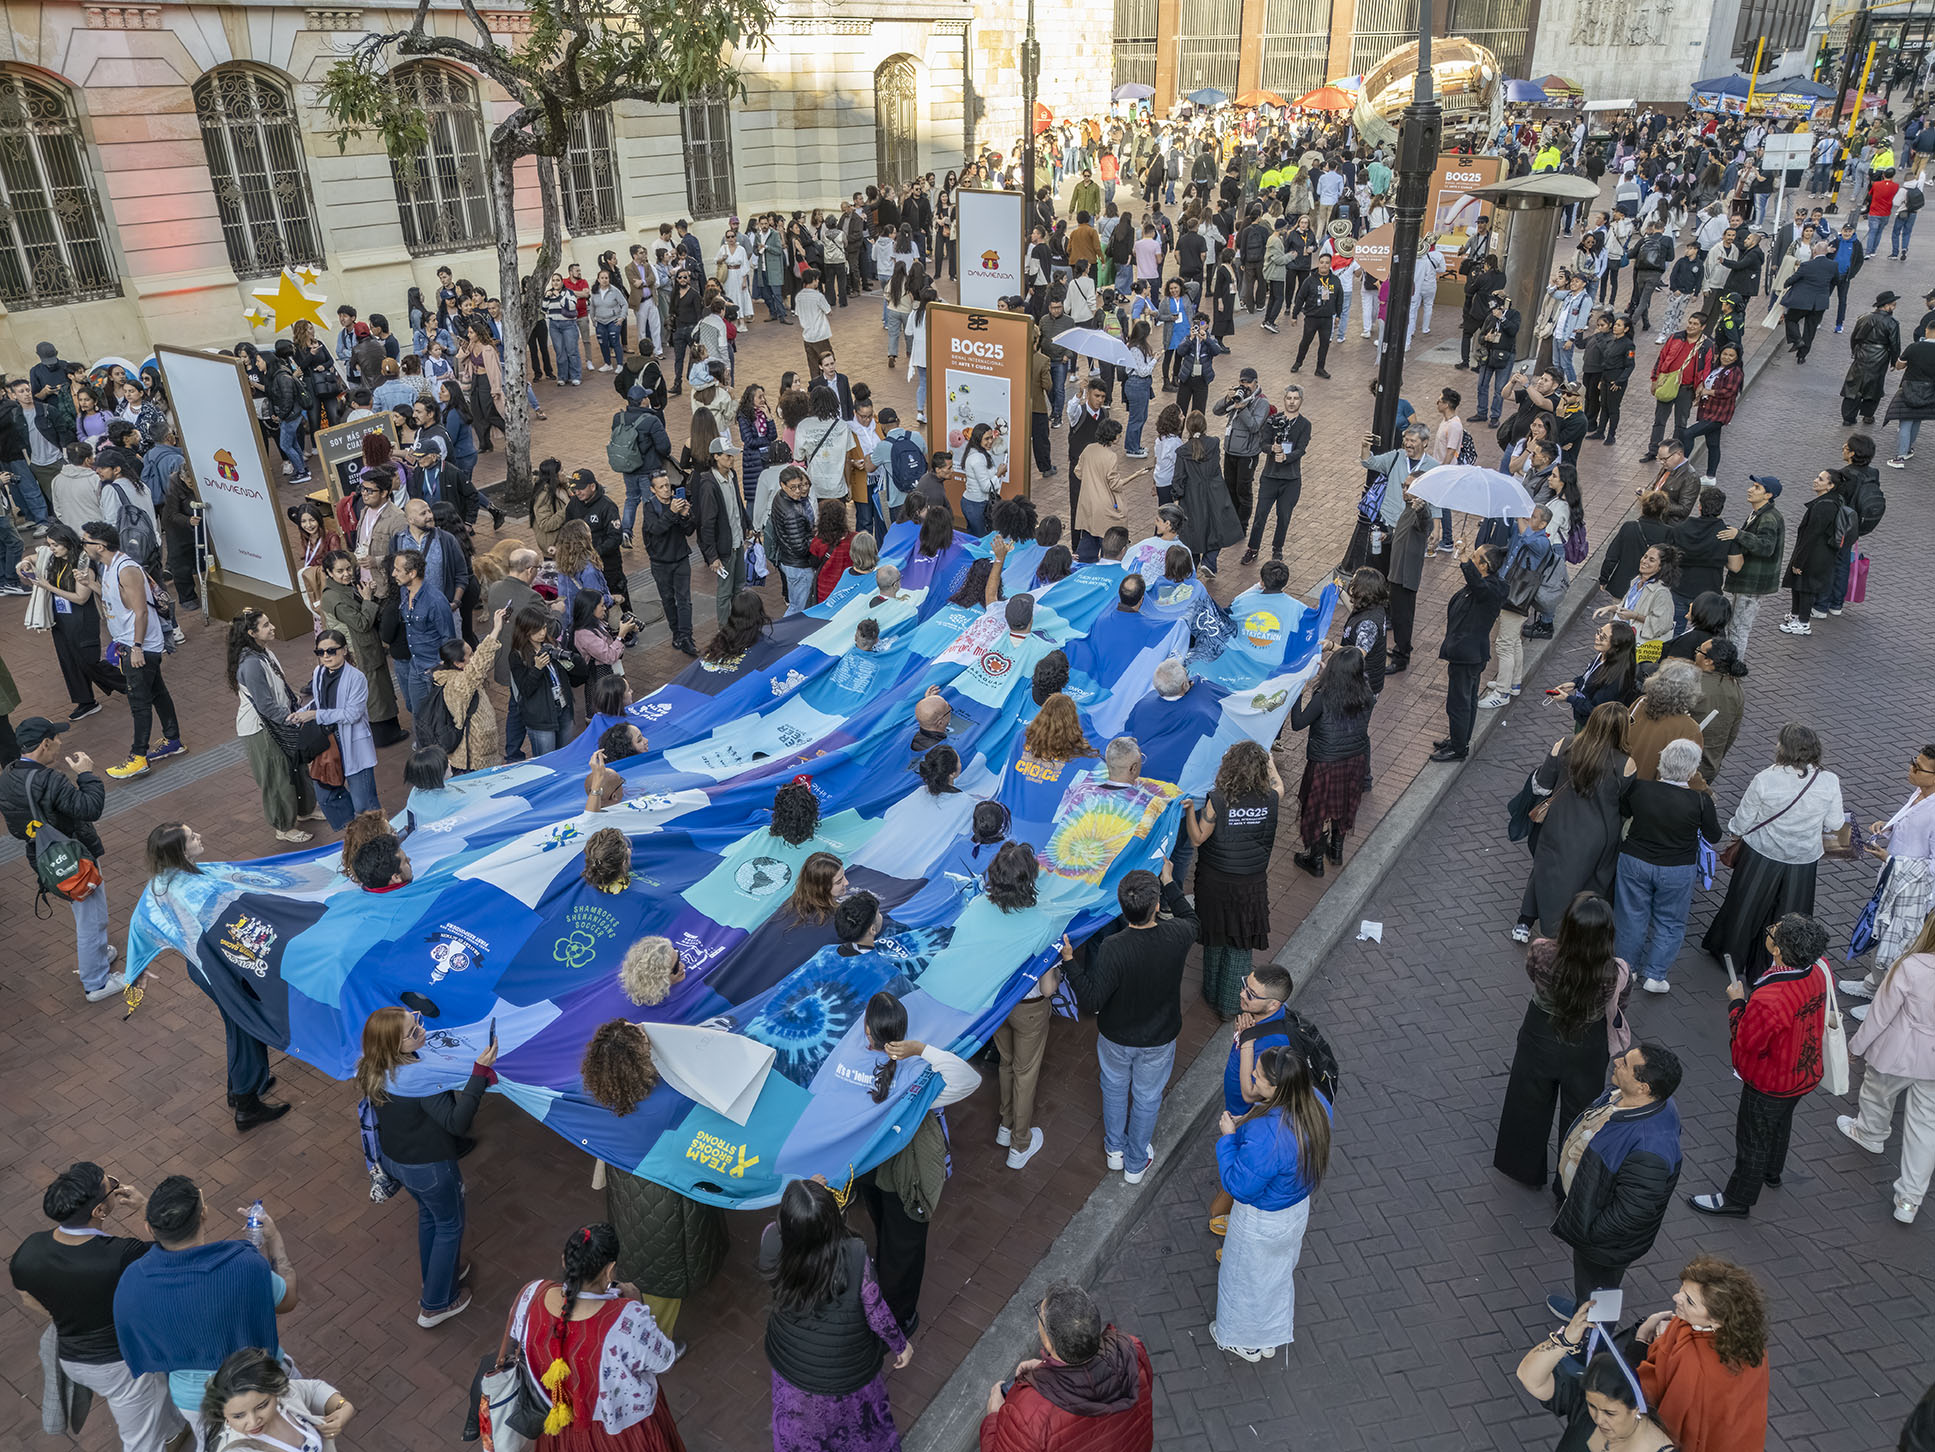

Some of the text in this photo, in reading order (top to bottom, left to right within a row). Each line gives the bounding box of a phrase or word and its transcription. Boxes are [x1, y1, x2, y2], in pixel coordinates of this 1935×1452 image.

[1445, 171, 1482, 182] BOG25
[1355, 245, 1390, 255] BOG25
[967, 270, 1014, 280] DAVIVIENDA
[951, 337, 1004, 360] BOG25
[329, 437, 343, 448] SOY
[346, 430, 360, 442] MÁS
[204, 477, 263, 500] DAVIVIENDA
[1241, 628, 1282, 641] STAYCATION
[1014, 759, 1062, 782] CHOICE
[1228, 807, 1268, 818] BOG25
[566, 913, 617, 939] SHENANIGANS
[573, 905, 620, 928] SHAMROCKS
[575, 921, 605, 938] SOCCER
[690, 1138, 733, 1164] BROOKS
[696, 1130, 737, 1155] STRONG
[685, 1147, 726, 1174] TEAM
